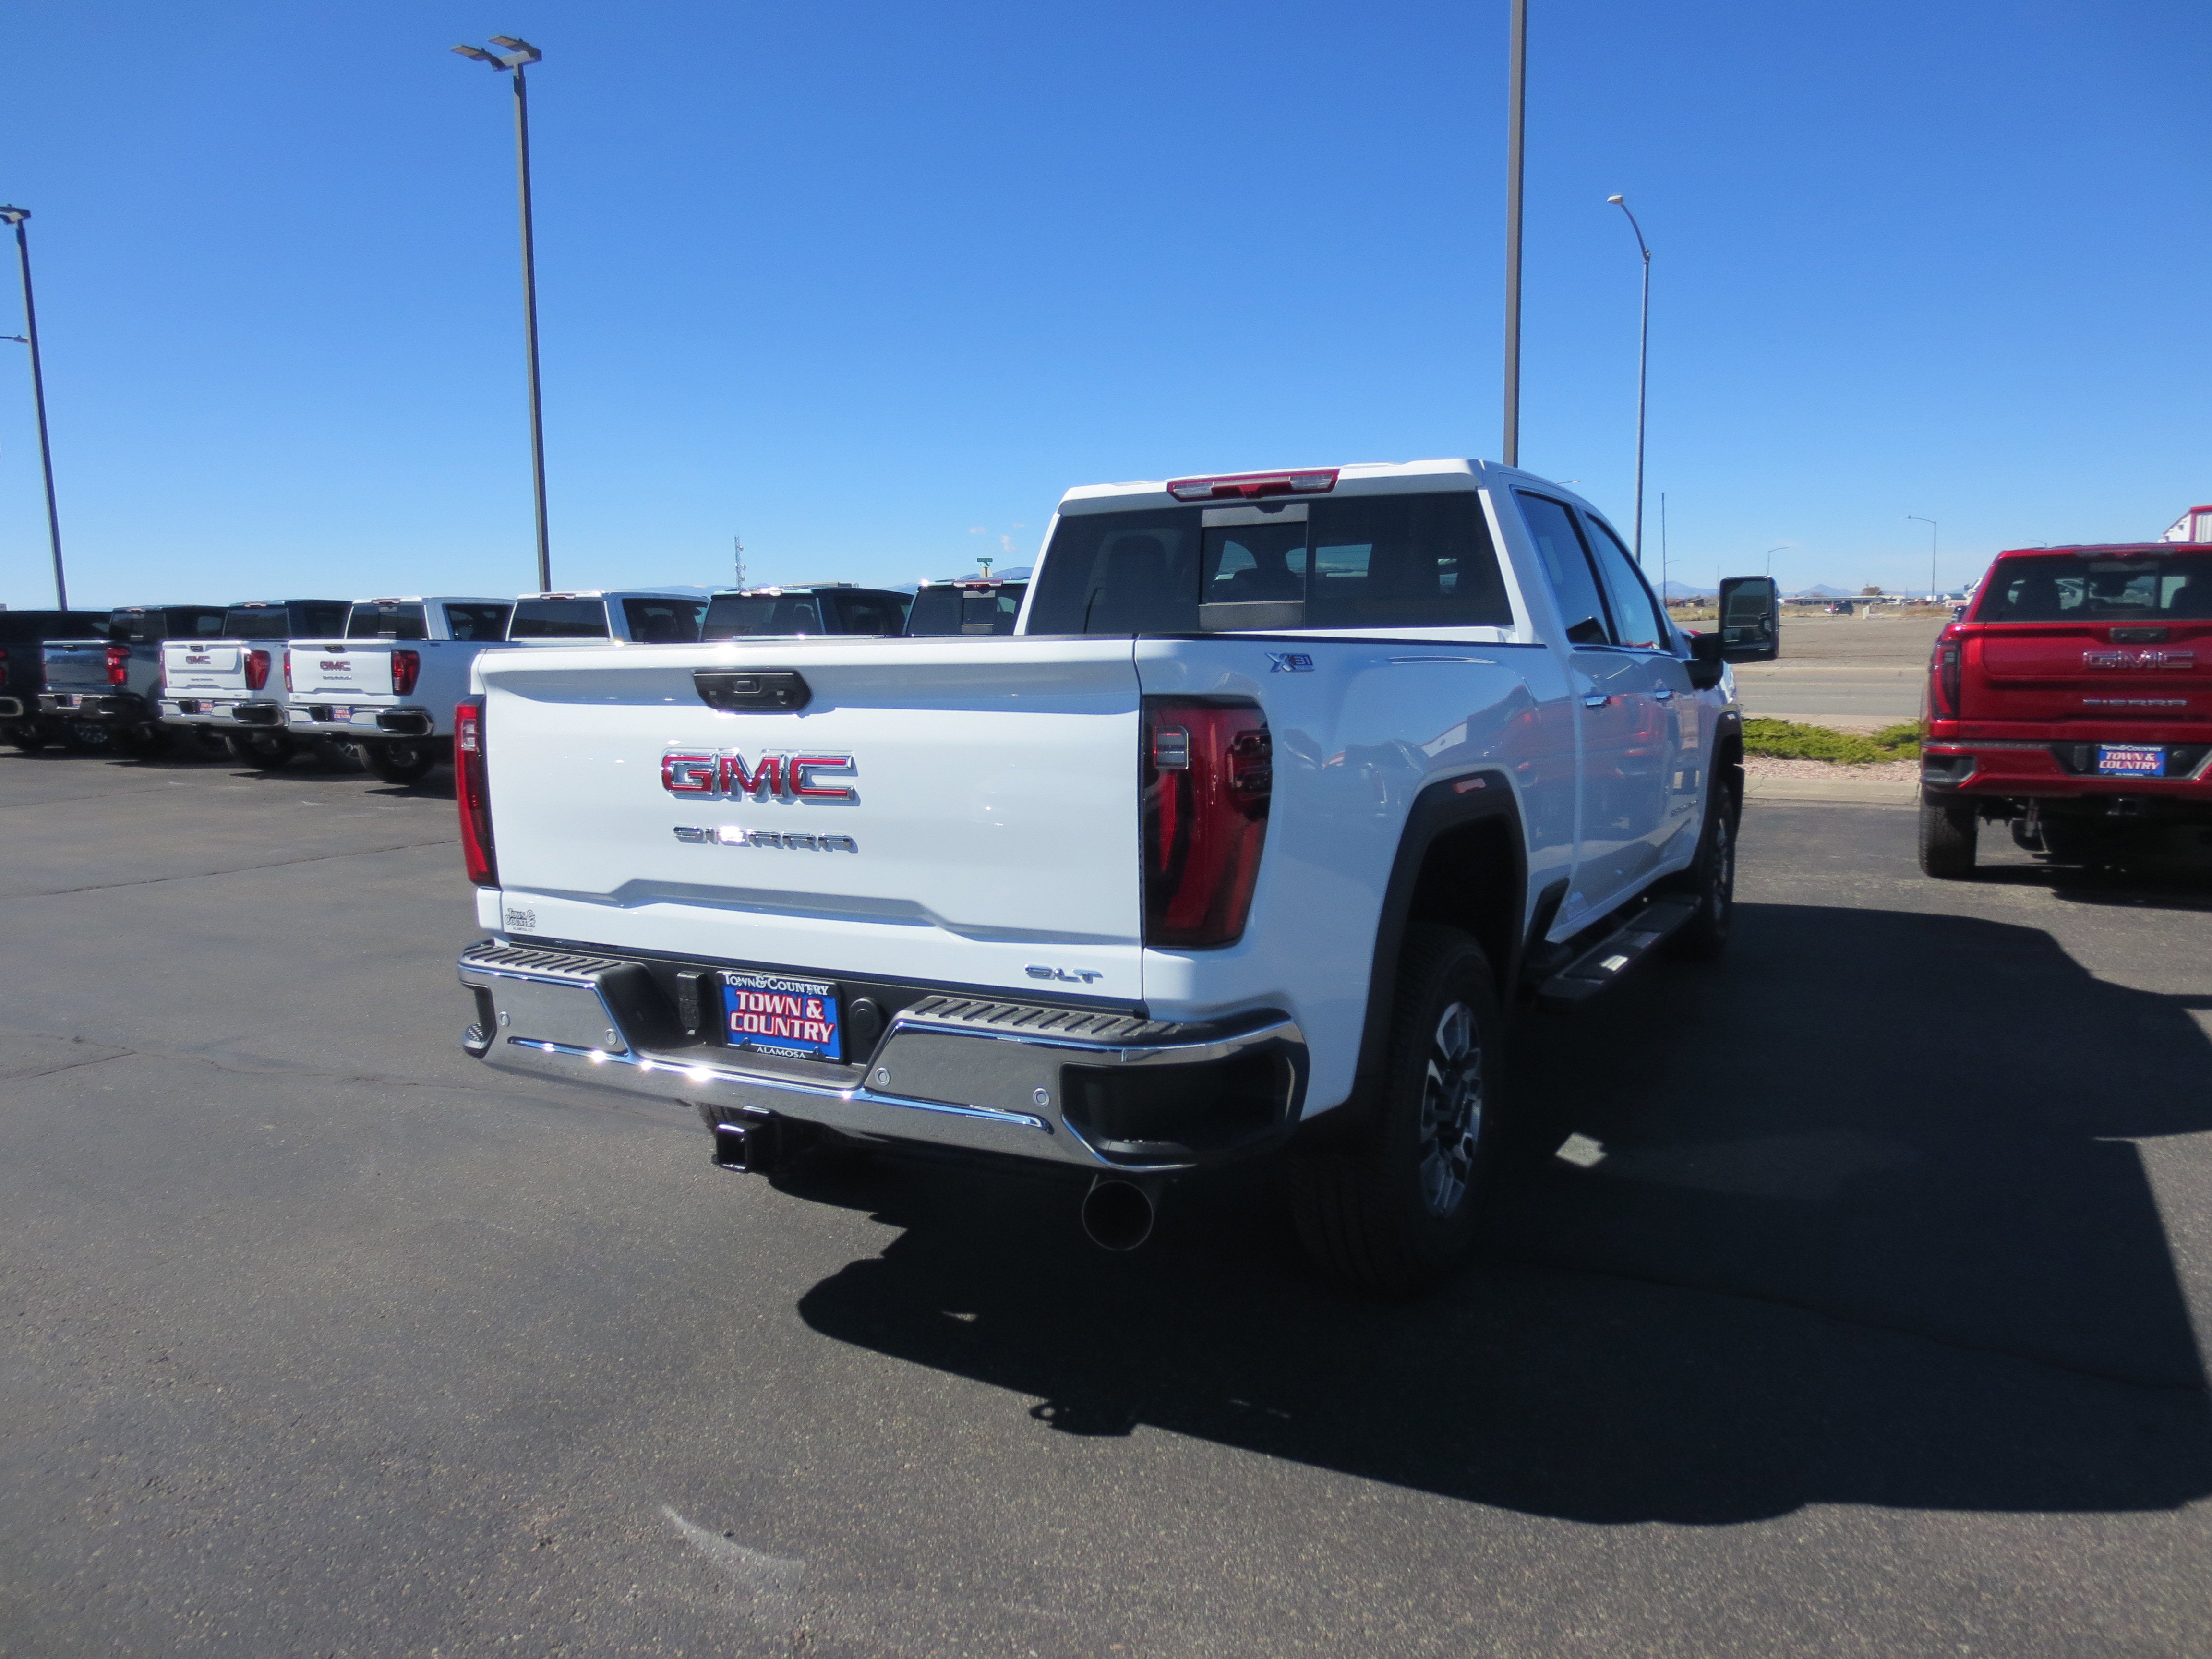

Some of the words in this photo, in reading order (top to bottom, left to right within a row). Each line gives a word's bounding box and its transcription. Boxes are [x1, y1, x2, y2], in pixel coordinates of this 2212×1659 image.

[320, 661, 351, 671] GMC
[2083, 651, 2194, 668] GMC
[2106, 751, 2144, 761] TOWN
[2145, 753, 2156, 761] &
[2099, 760, 2163, 770] COUNTRY
[661, 747, 857, 801] GMC
[1024, 963, 1104, 984] SLT
[735, 989, 802, 1017] TOWN
[805, 998, 825, 1020] &
[729, 1010, 835, 1044] COUNTRY
[757, 1046, 806, 1059] ALAMOSA
